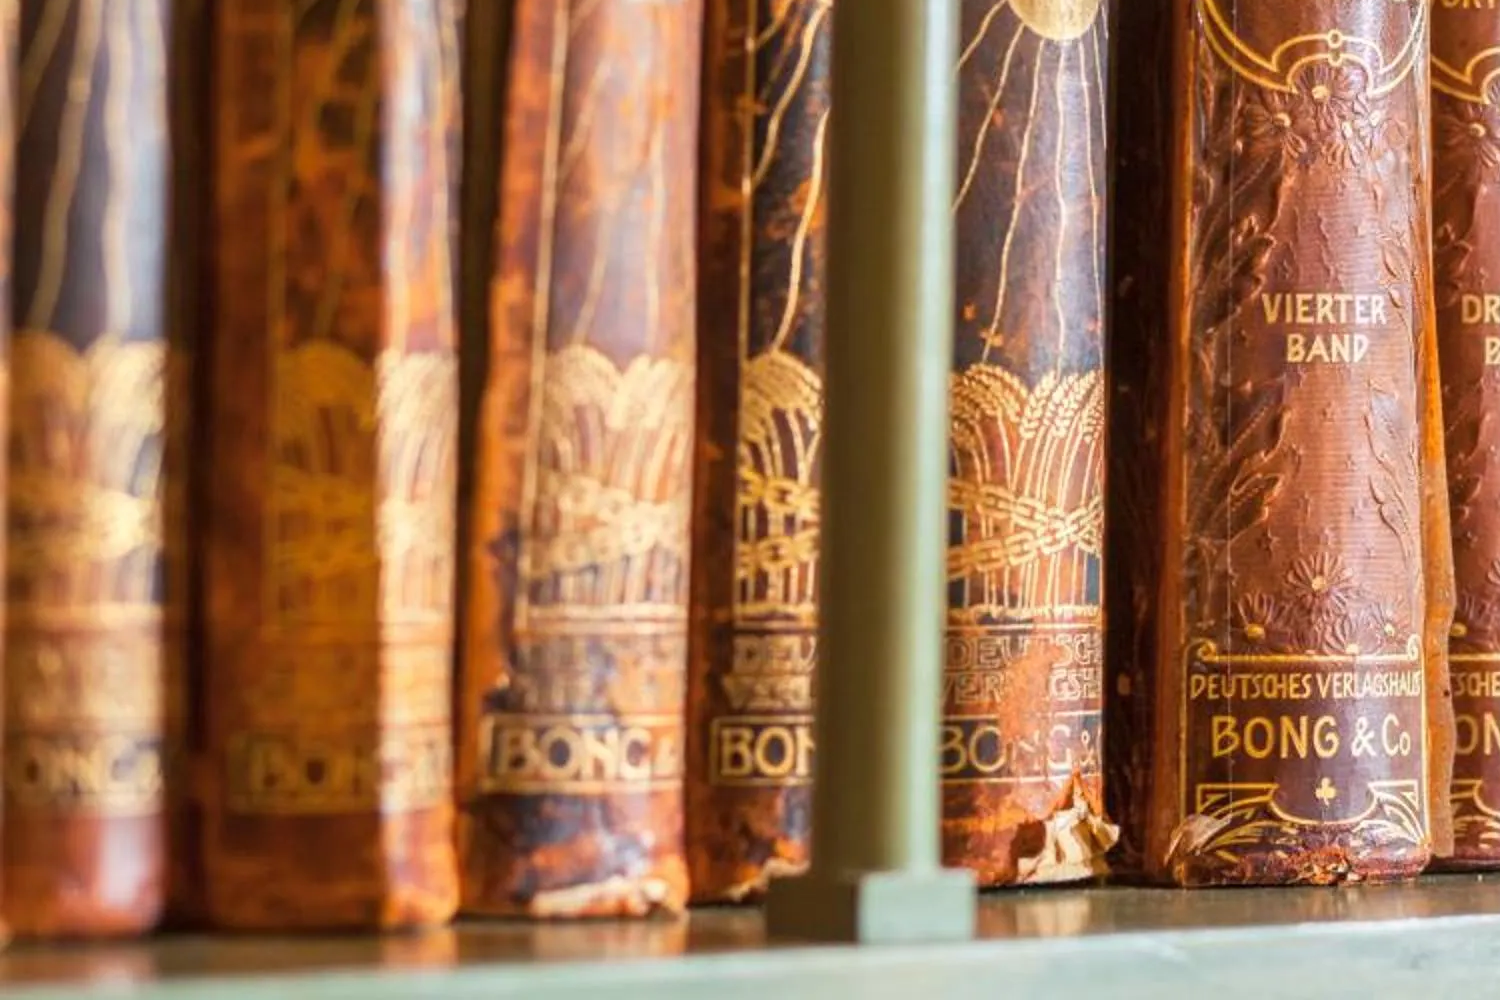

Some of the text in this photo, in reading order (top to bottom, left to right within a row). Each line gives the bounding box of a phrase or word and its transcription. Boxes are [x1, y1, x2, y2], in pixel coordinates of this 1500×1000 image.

[1261, 292, 1388, 325] VIERTER
[1286, 333, 1370, 363] BAND
[1190, 672, 1312, 700] DEUTSCHES
[1211, 712, 1411, 760] BONG & Co
